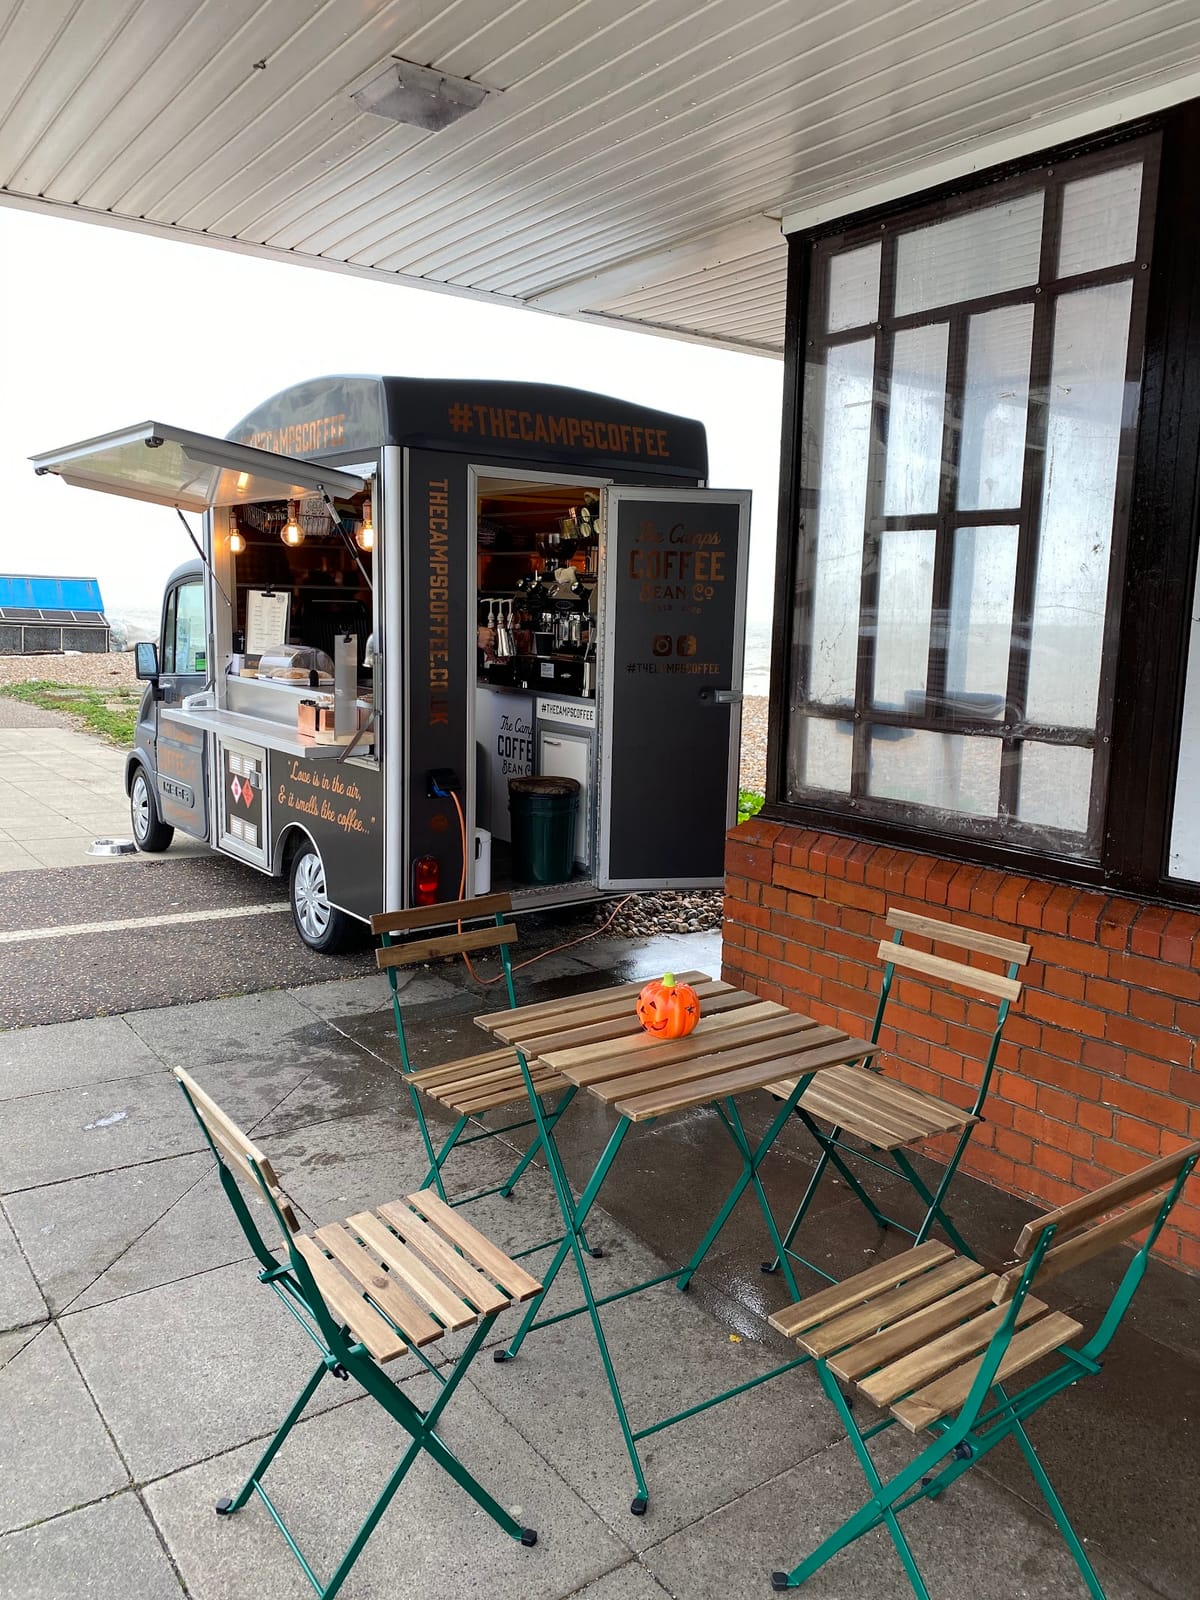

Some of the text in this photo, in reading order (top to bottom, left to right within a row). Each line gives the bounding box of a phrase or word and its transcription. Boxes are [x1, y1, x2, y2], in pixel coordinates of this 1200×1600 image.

[448, 402, 670, 457] #THECAMPSCOFFEE
[629, 549, 726, 581] COFFEE
[640, 583, 687, 604] BEAN
[626, 663, 720, 675] #THEMPSCOFFEE
[541, 703, 594, 721] #THECAMPSCOFFEE
[500, 714, 513, 732] The
[502, 759, 523, 775] BEAN
[312, 770, 320, 787] is
[321, 773, 330, 790] in
[331, 774, 345, 795] the
[346, 782, 362, 802] air,
[278, 784, 286, 804] &
[287, 792, 295, 807] it
[295, 794, 319, 817] smells
[320, 799, 335, 822] like
